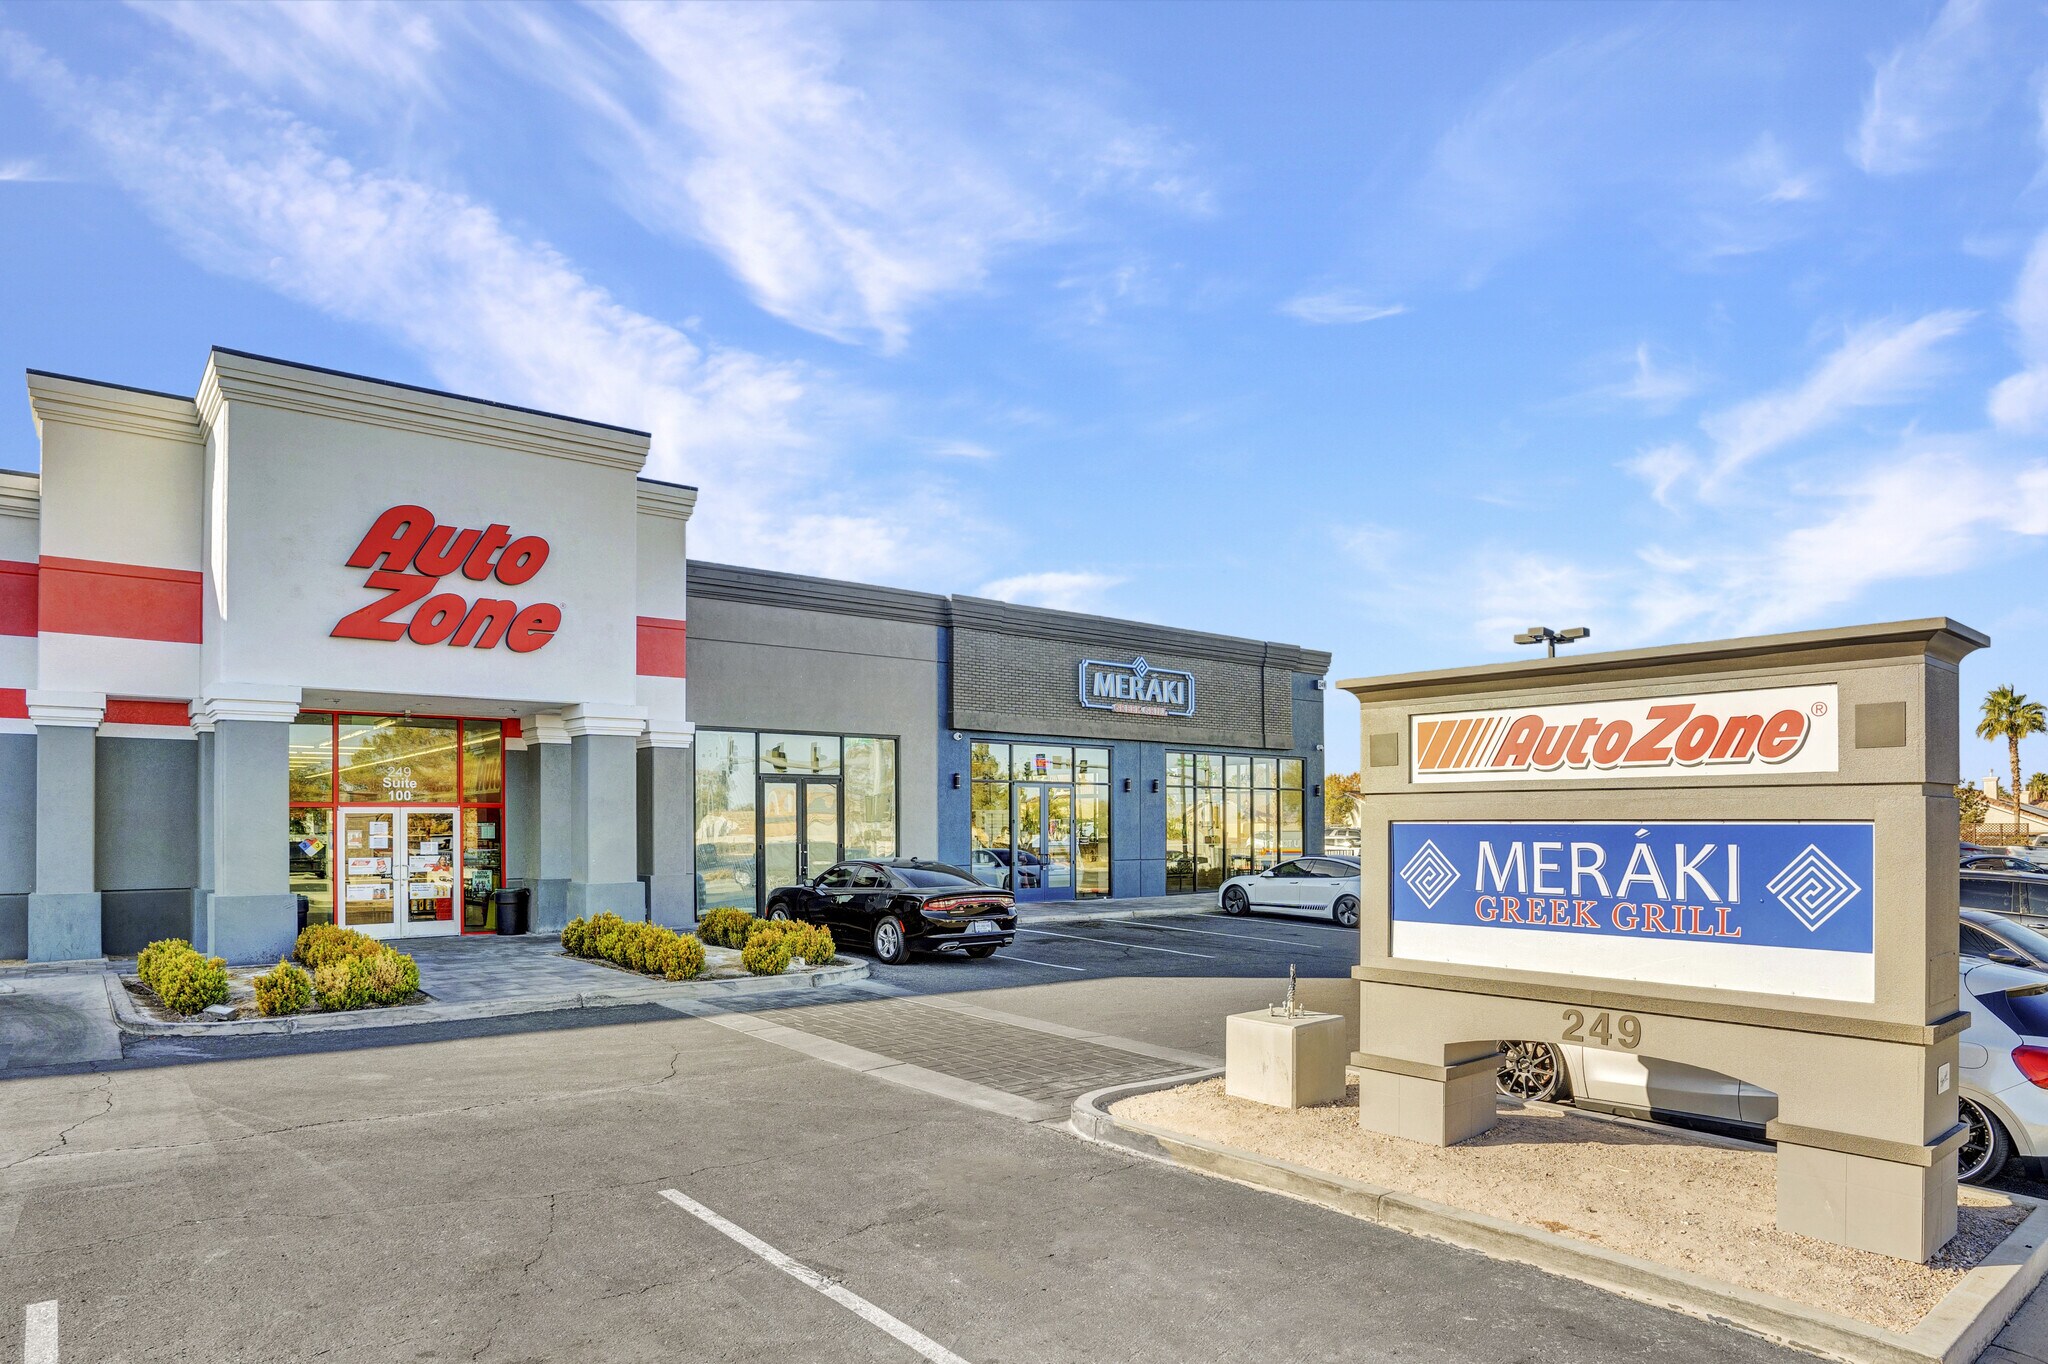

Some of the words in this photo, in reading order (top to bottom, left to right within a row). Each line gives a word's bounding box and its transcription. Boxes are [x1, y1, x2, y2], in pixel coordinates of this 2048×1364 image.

[344, 504, 550, 586] Auto
[329, 570, 562, 653] Zone
[1490, 703, 1809, 769] AutoZone
[383, 777, 417, 789] Suite
[387, 766, 412, 778] 249
[389, 790, 412, 801] 100
[1475, 827, 1741, 904] MERÁKI
[1475, 895, 1601, 928] GREEK
[1611, 902, 1743, 938] GRILL
[1561, 1008, 1642, 1049] 249
